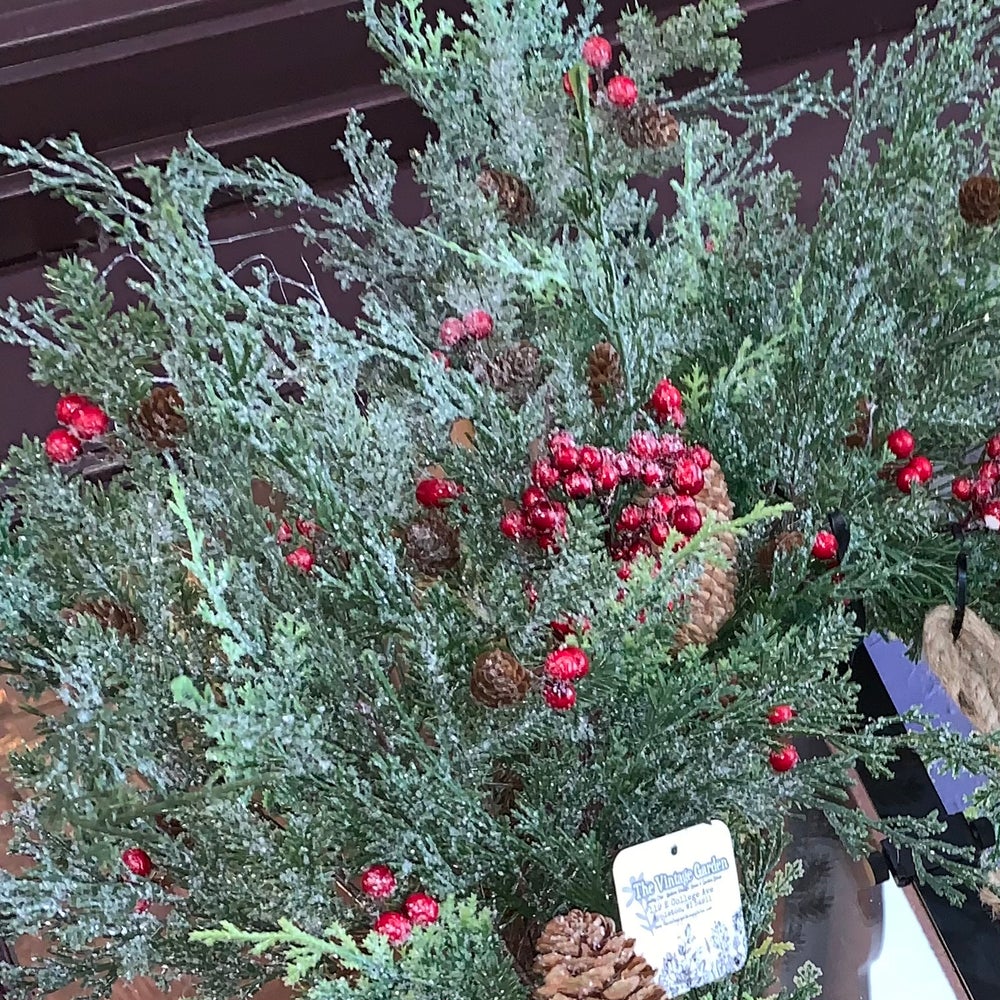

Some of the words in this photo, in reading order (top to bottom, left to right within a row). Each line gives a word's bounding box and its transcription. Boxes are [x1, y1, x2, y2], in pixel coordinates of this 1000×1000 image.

[631, 880, 655, 901] The
[653, 868, 693, 892] Vintage
[693, 855, 729, 879] Garden
[670, 892, 700, 905] College
[702, 887, 714, 895] Ave
